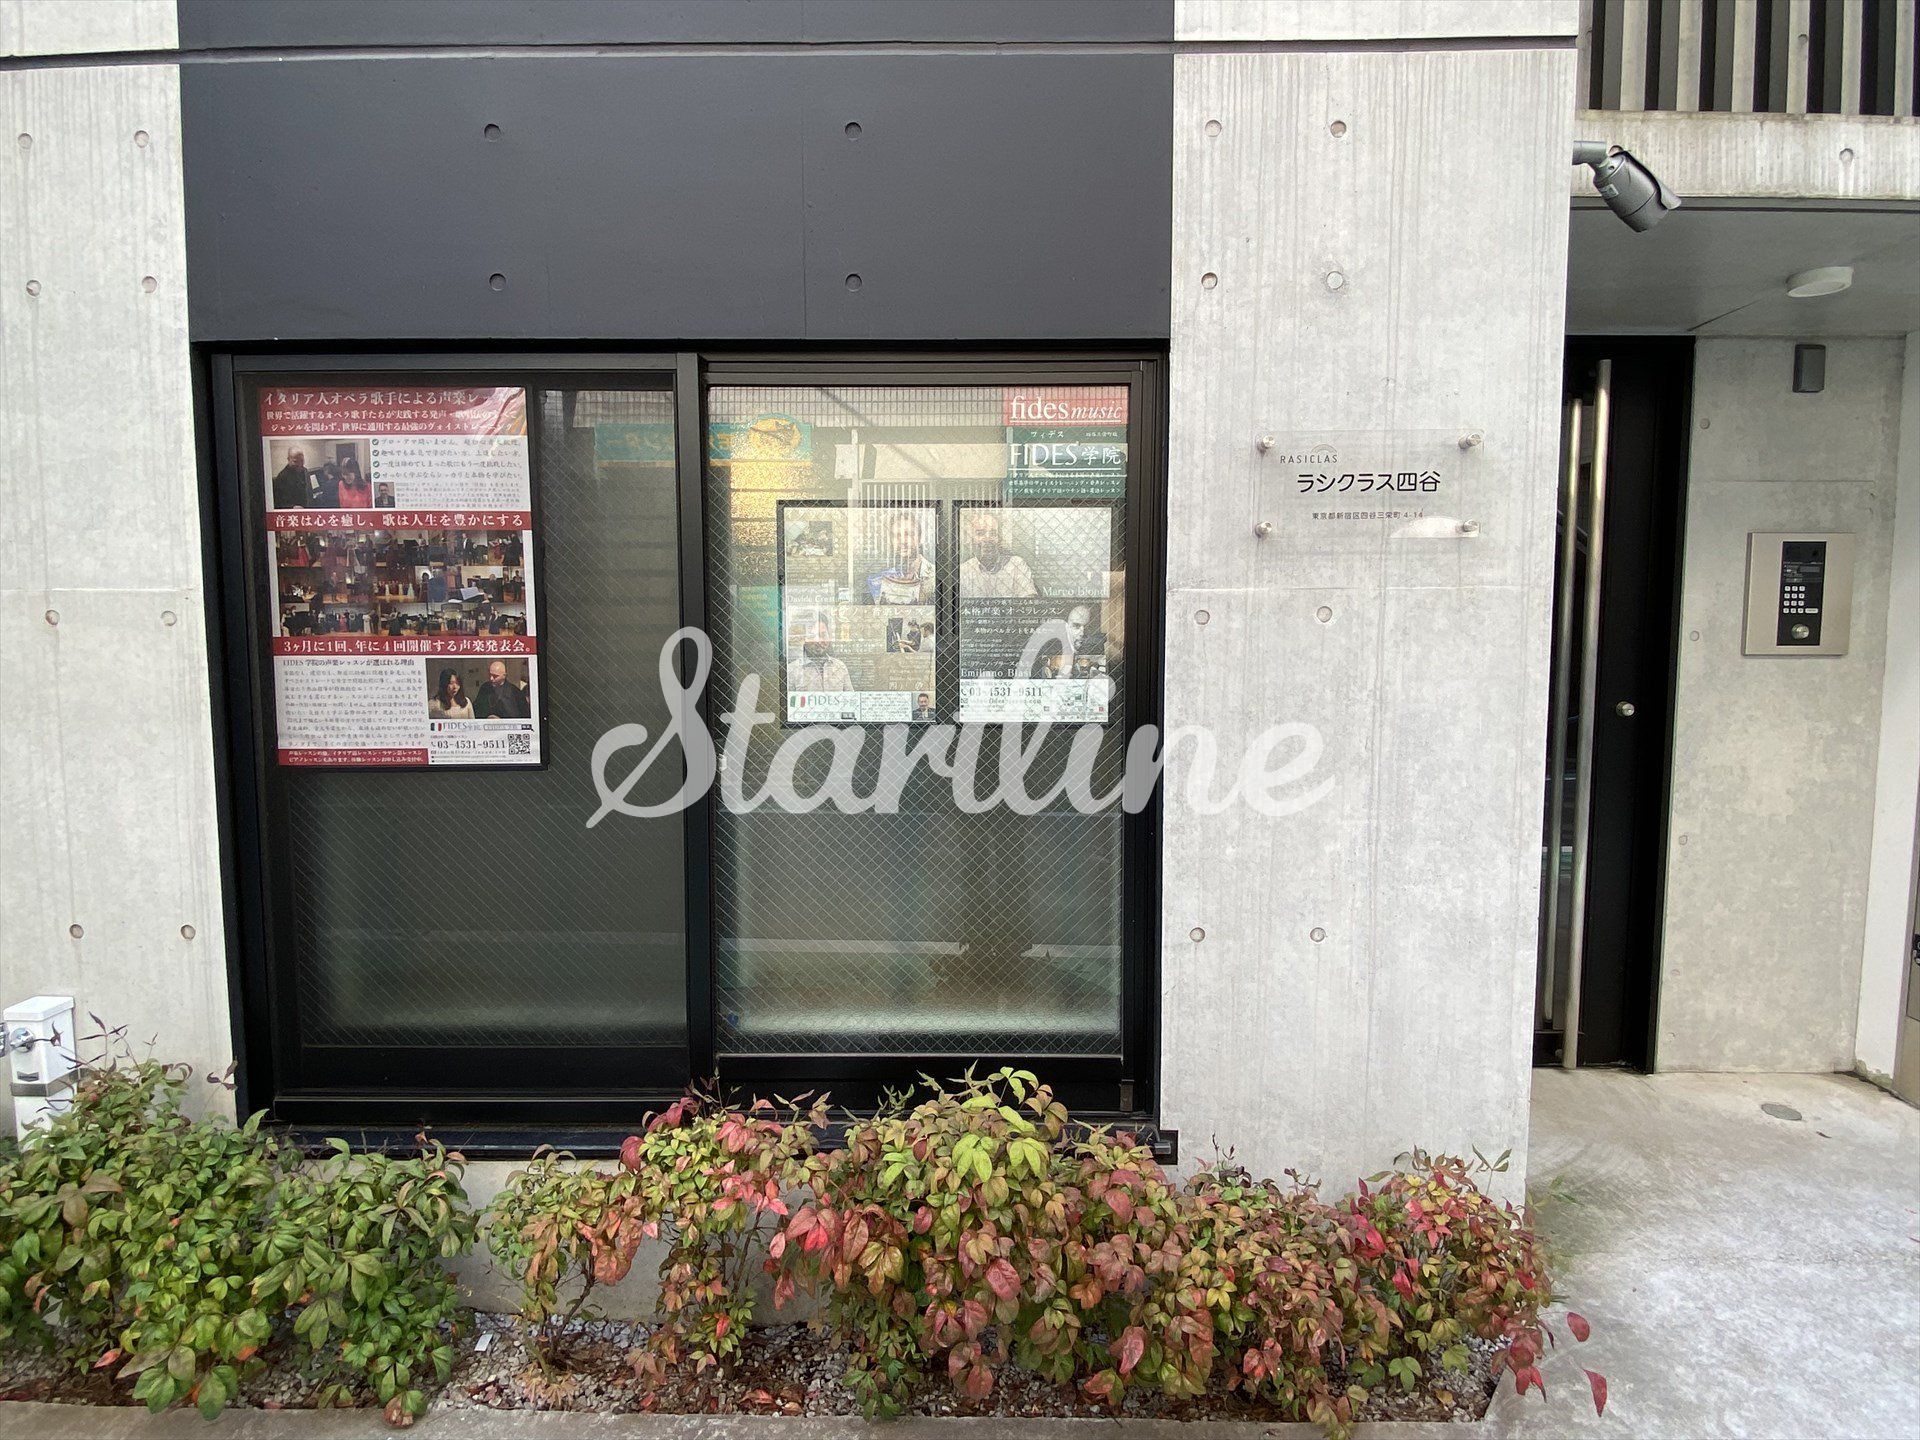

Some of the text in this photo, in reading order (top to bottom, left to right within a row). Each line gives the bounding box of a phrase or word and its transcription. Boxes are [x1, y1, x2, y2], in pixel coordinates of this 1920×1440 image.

[265, 391, 515, 405] イタリア人オペラ歌手による声楽レ
[1031, 429, 1064, 438] フィデス
[1280, 454, 1338, 464] RASICLAS
[1297, 470, 1441, 493] ラシクラス四谷
[275, 513, 523, 528] 音楽は心を癒し、歌は人生を豊かにする
[961, 669, 1032, 677] Emiliano Blasi
[970, 687, 1042, 696] 03-4531-9511
[437, 740, 506, 749] 03-4531-9511
